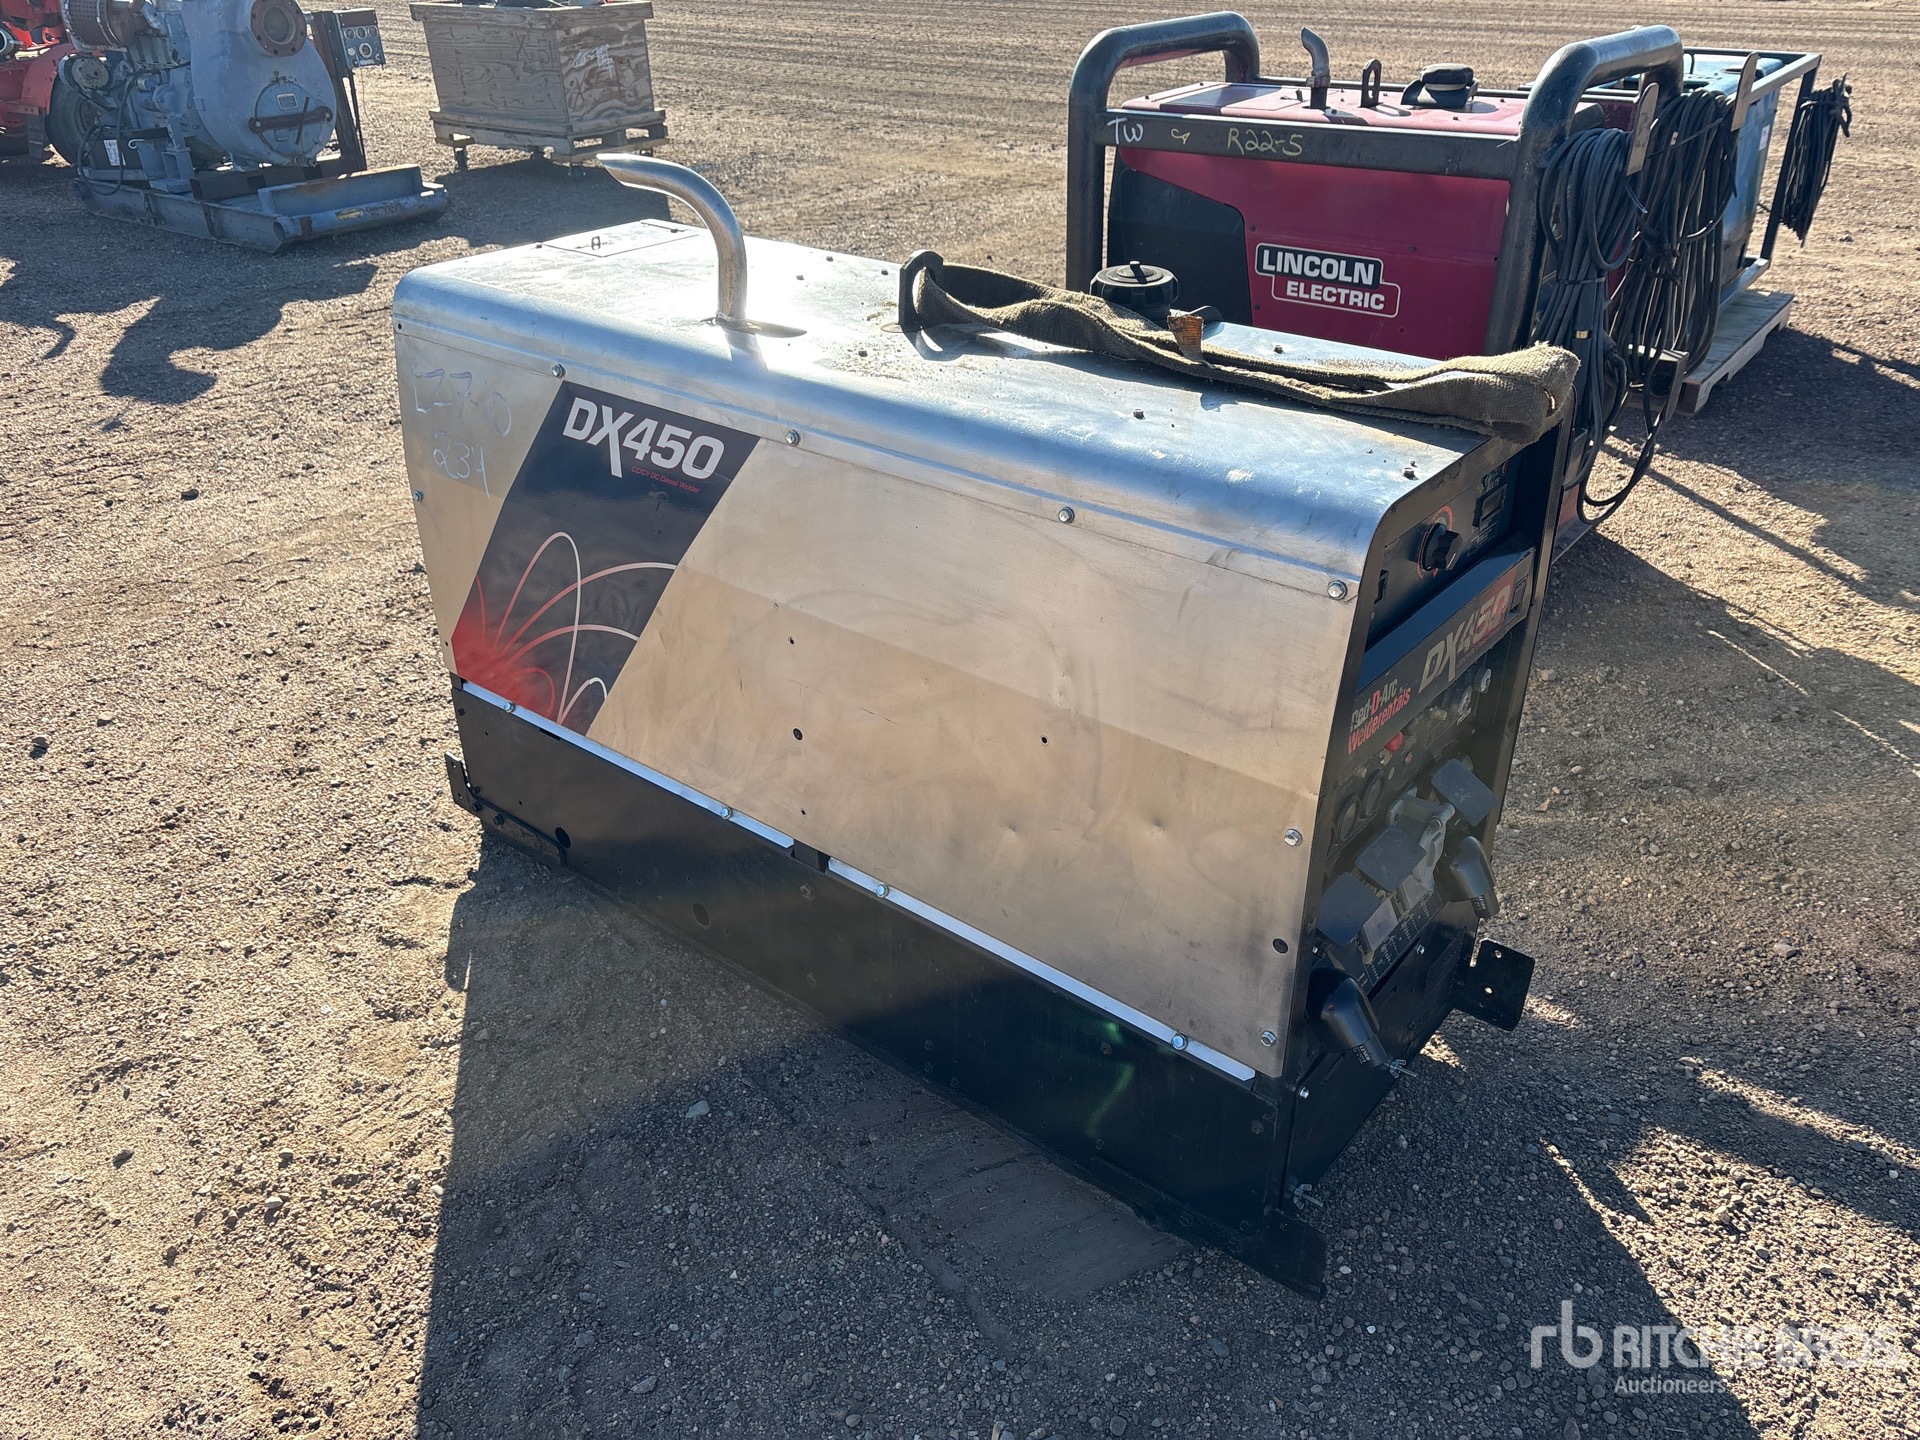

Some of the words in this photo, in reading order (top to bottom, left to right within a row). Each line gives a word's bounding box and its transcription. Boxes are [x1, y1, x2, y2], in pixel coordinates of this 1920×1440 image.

[1107, 116, 1144, 145] TW
[1227, 127, 1303, 156] R22-5
[1262, 249, 1375, 286] LINCOLN
[1286, 281, 1385, 310] ELECTRIC
[562, 396, 726, 479] DX450
[1418, 584, 1511, 694] DX450
